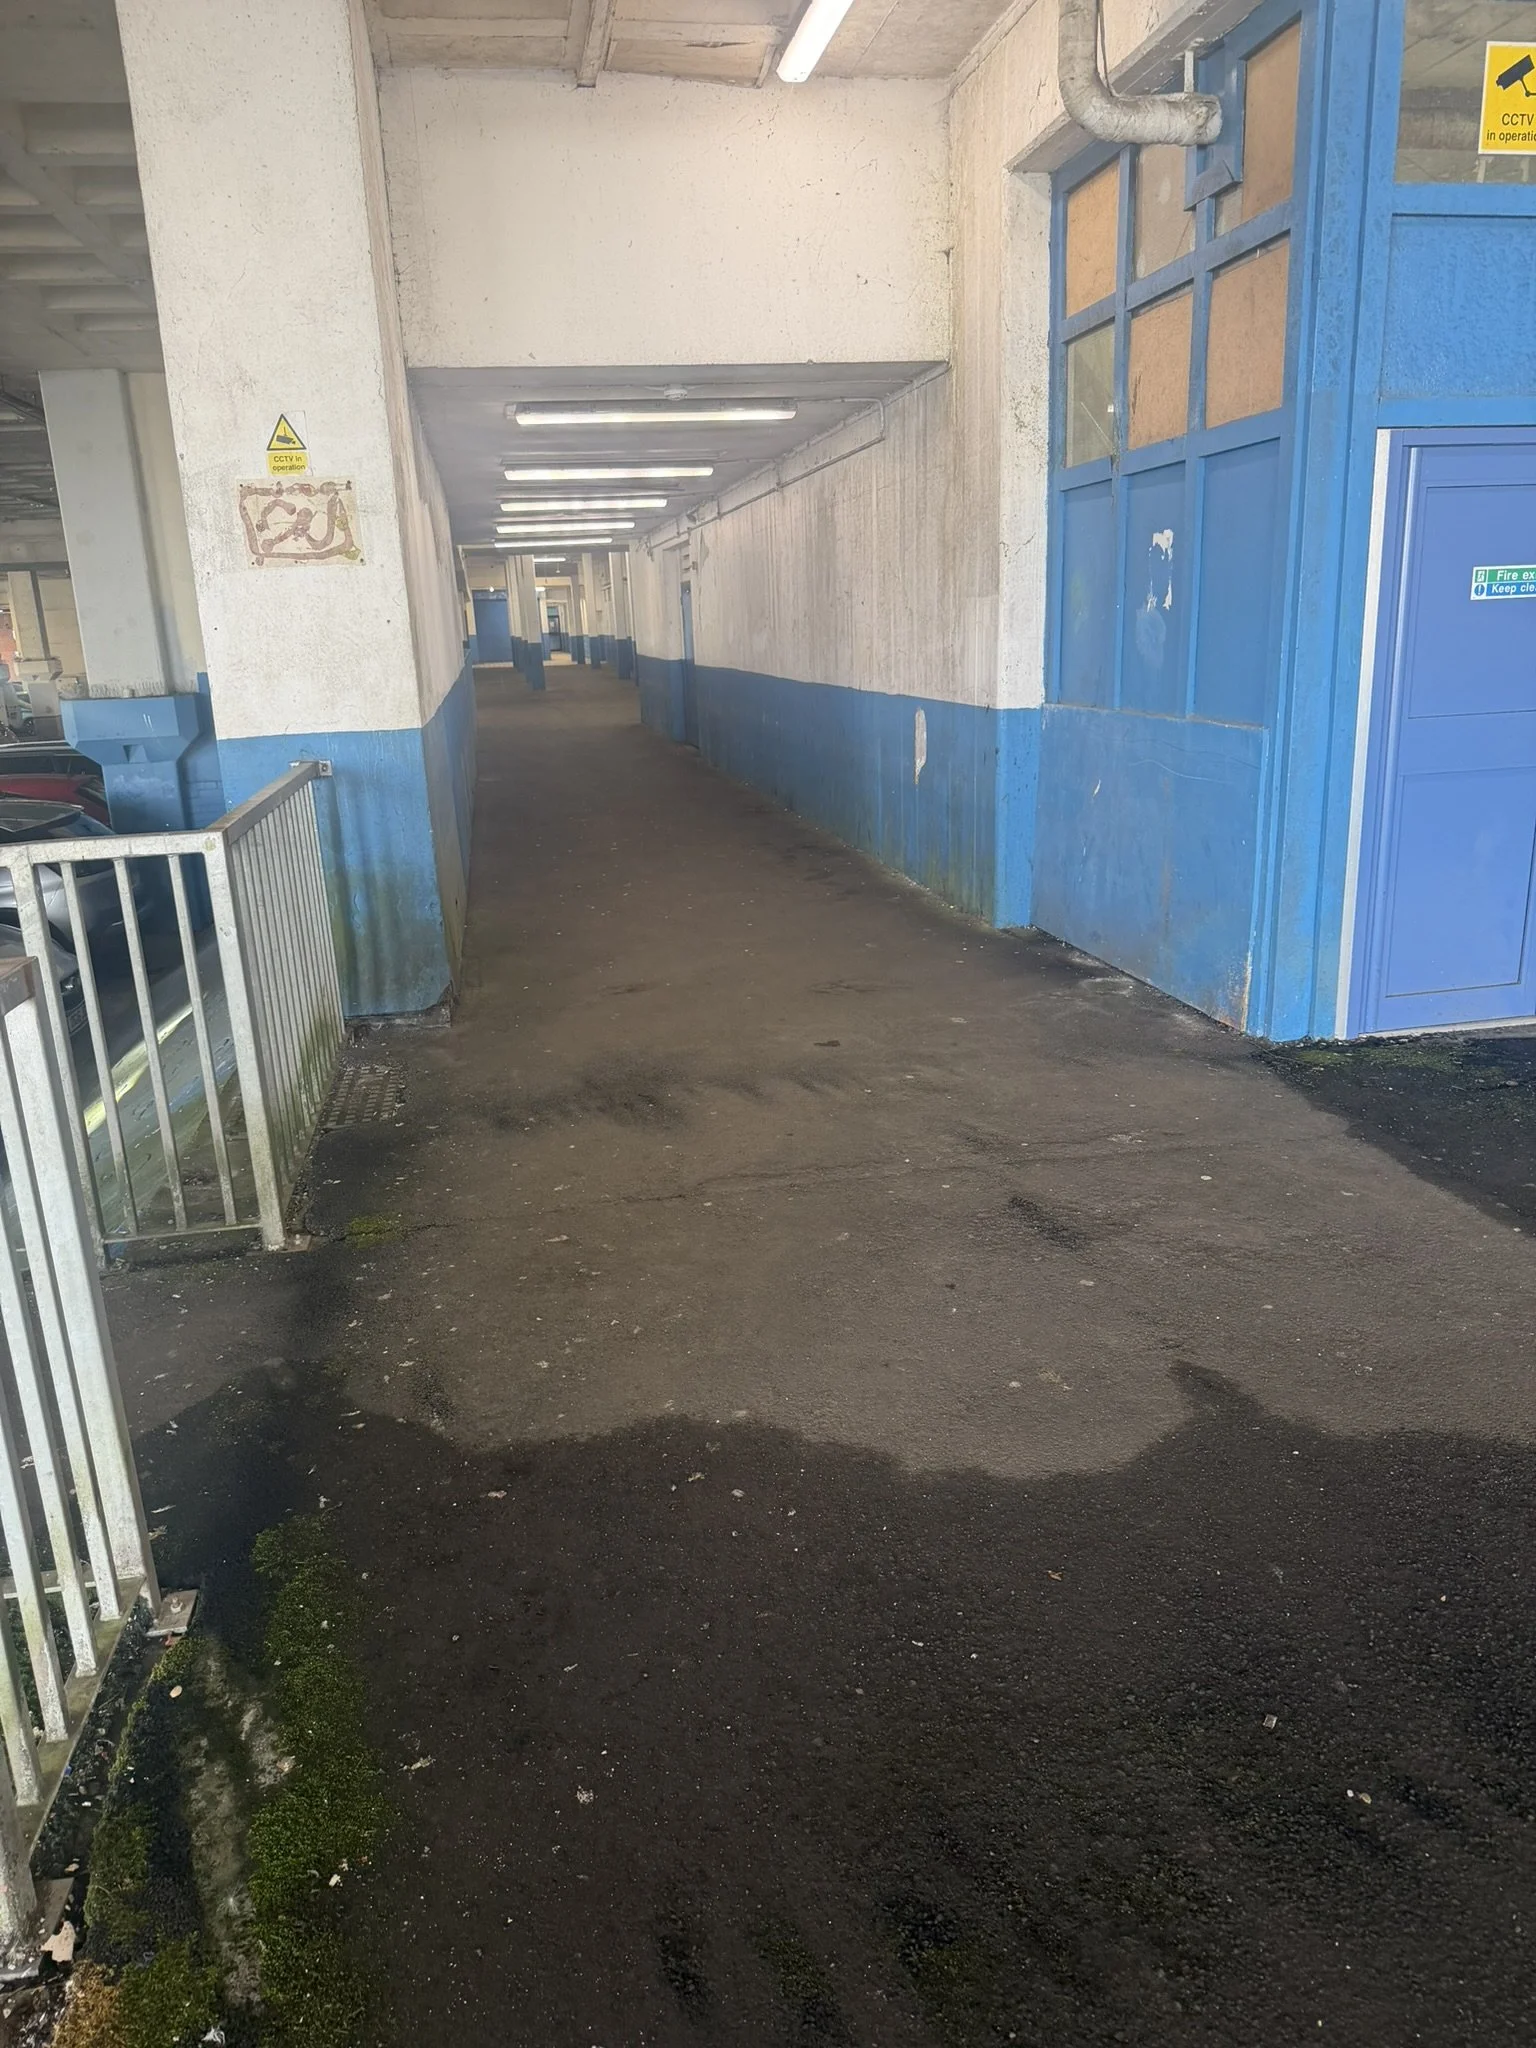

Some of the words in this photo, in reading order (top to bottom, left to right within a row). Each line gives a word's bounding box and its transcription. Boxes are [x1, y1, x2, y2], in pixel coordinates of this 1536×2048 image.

[1501, 113, 1535, 126] CCTV
[1486, 129, 1496, 141] in
[273, 455, 294, 463] CCTV
[272, 464, 306, 472] operation
[1496, 570, 1519, 581] Fire
[1522, 570, 1536, 580] ex
[1491, 583, 1517, 596] Keep
[1520, 582, 1536, 592] cle
